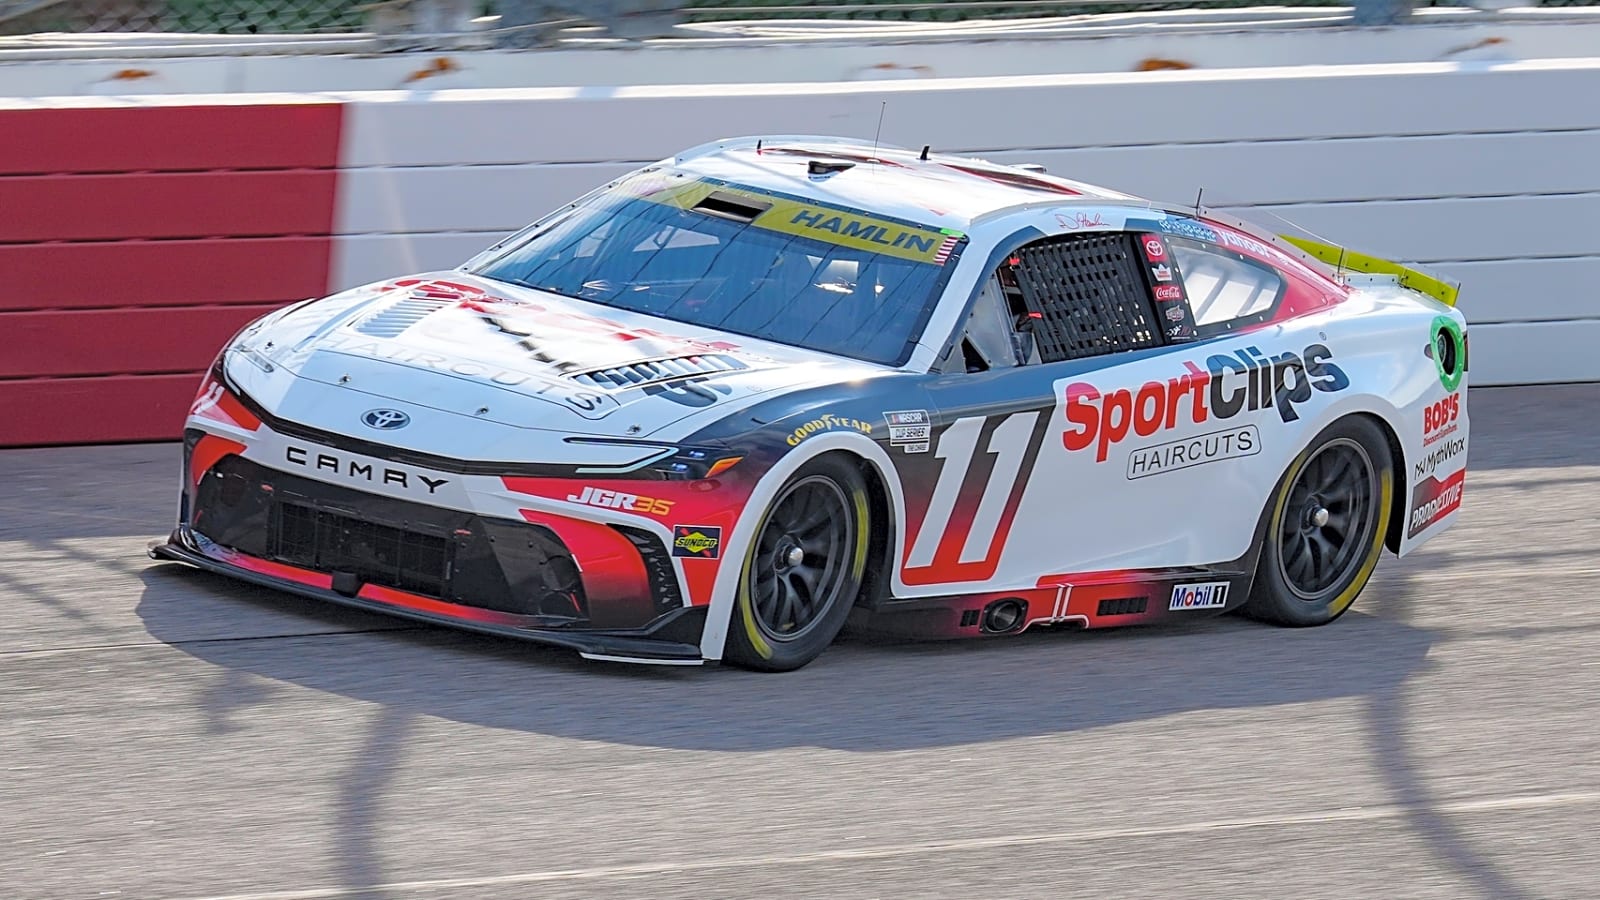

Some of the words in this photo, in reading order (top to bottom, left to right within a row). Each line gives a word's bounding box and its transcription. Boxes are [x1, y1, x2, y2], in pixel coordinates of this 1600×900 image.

[790, 210, 936, 252] HAMLIN
[323, 335, 603, 412] HAIRCUTS
[786, 413, 873, 447] GOODYEAR
[897, 412, 923, 423] NASCAR
[1424, 392, 1459, 435] BOB'S
[286, 446, 449, 494] CAMRY
[1132, 431, 1253, 474] HAIRCUTS
[904, 411, 1040, 569] 11
[676, 537, 718, 549] SUNOCO
[1172, 587, 1211, 608] Mobil
[1215, 587, 1225, 603] 1
